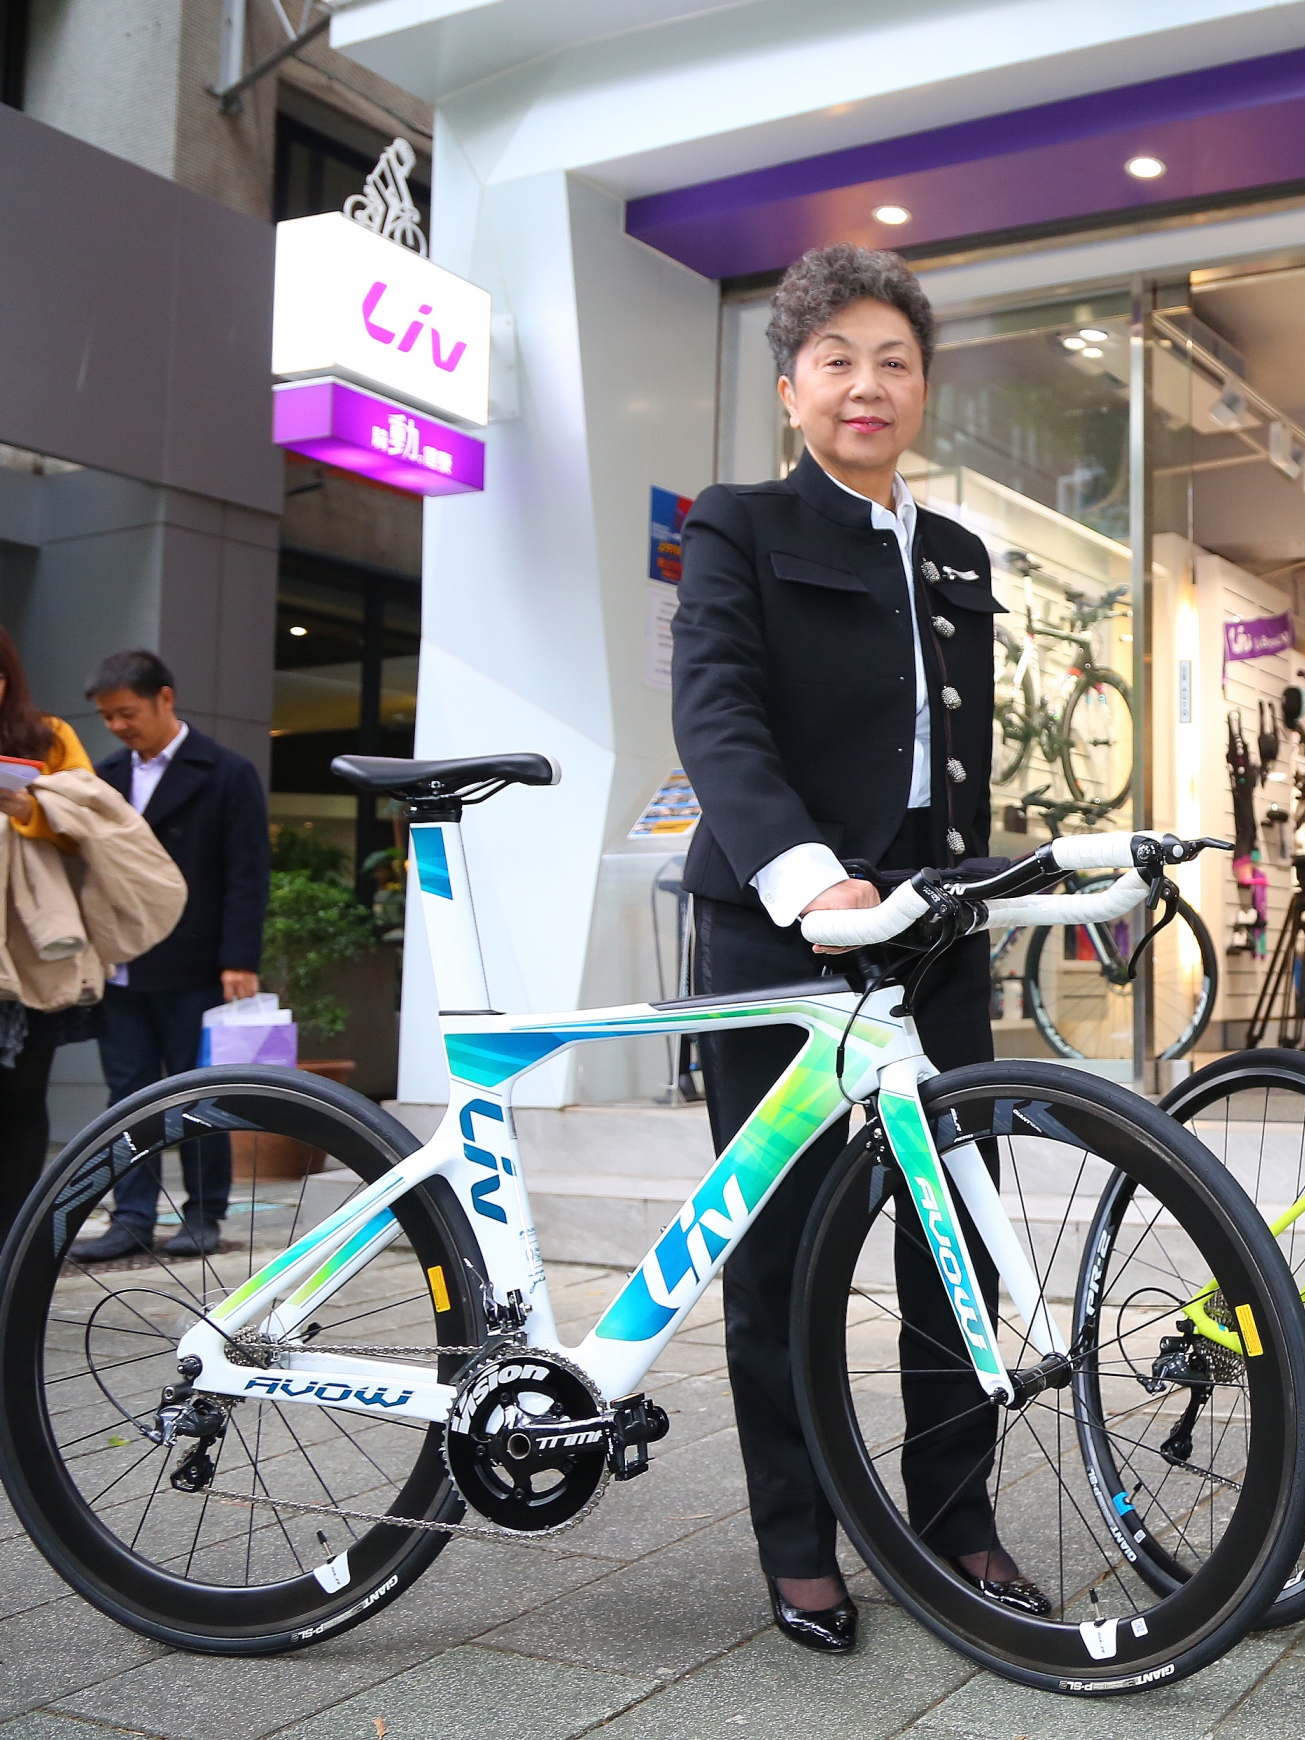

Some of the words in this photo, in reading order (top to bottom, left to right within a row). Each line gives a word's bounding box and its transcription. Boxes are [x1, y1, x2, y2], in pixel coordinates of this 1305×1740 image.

[362, 281, 467, 372] Liv
[459, 1098, 517, 1225] Liv
[642, 1173, 751, 1310] Liv
[913, 1175, 988, 1352] AVOW
[244, 1376, 416, 1408] AVOW
[362, 1574, 399, 1608] GIANT
[1135, 1663, 1176, 1686] GIANT
